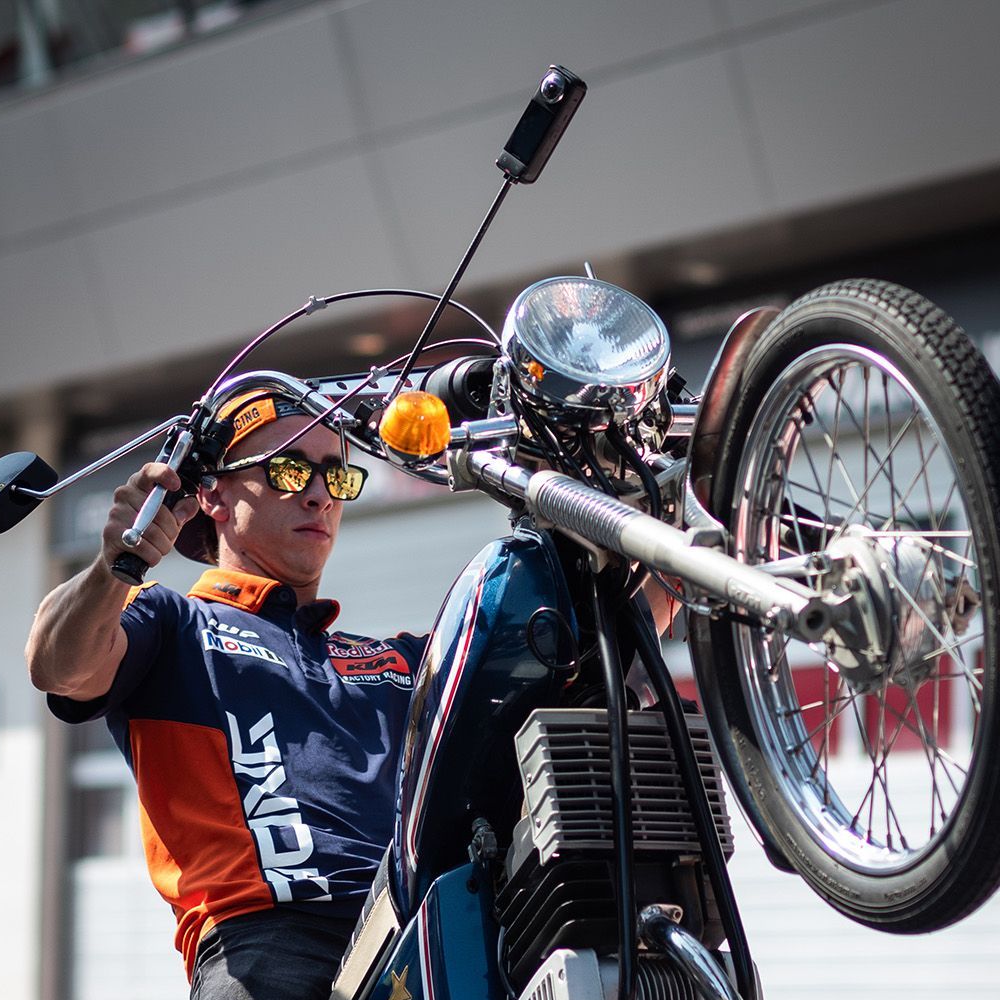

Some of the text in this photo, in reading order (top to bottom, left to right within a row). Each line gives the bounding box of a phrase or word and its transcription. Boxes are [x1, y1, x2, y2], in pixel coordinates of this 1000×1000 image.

[206, 632, 263, 656] Mobil
[326, 641, 393, 658] Red Bull
[346, 656, 398, 671] KTM
